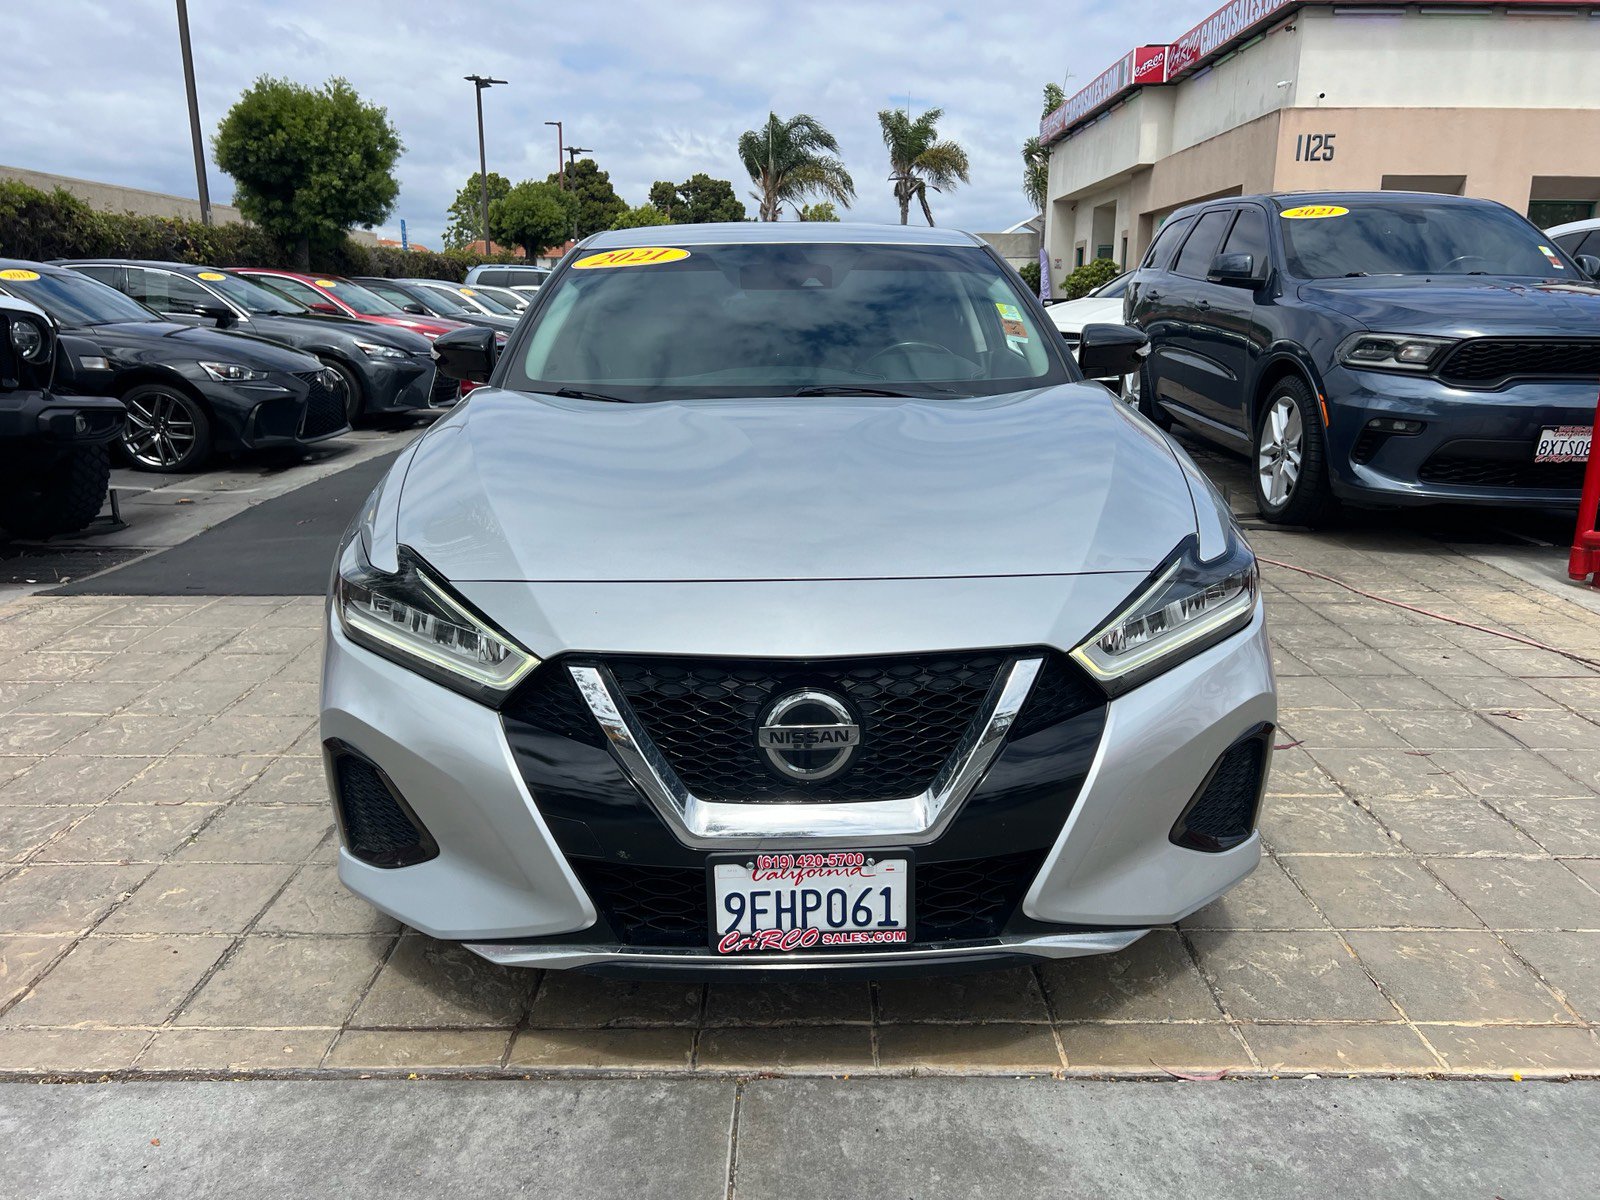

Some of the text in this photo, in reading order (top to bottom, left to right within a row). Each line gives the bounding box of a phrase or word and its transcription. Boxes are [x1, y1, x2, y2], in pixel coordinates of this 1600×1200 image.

[1134, 53, 1164, 77] CARCO
[1295, 133, 1336, 162] 1125
[1294, 208, 1335, 216] 2021
[589, 250, 671, 266] 2021
[769, 729, 849, 744] NISSAN
[757, 853, 864, 870] (619) 420-5700
[752, 866, 876, 886] California
[718, 927, 906, 954] CARCO SALES.COM
